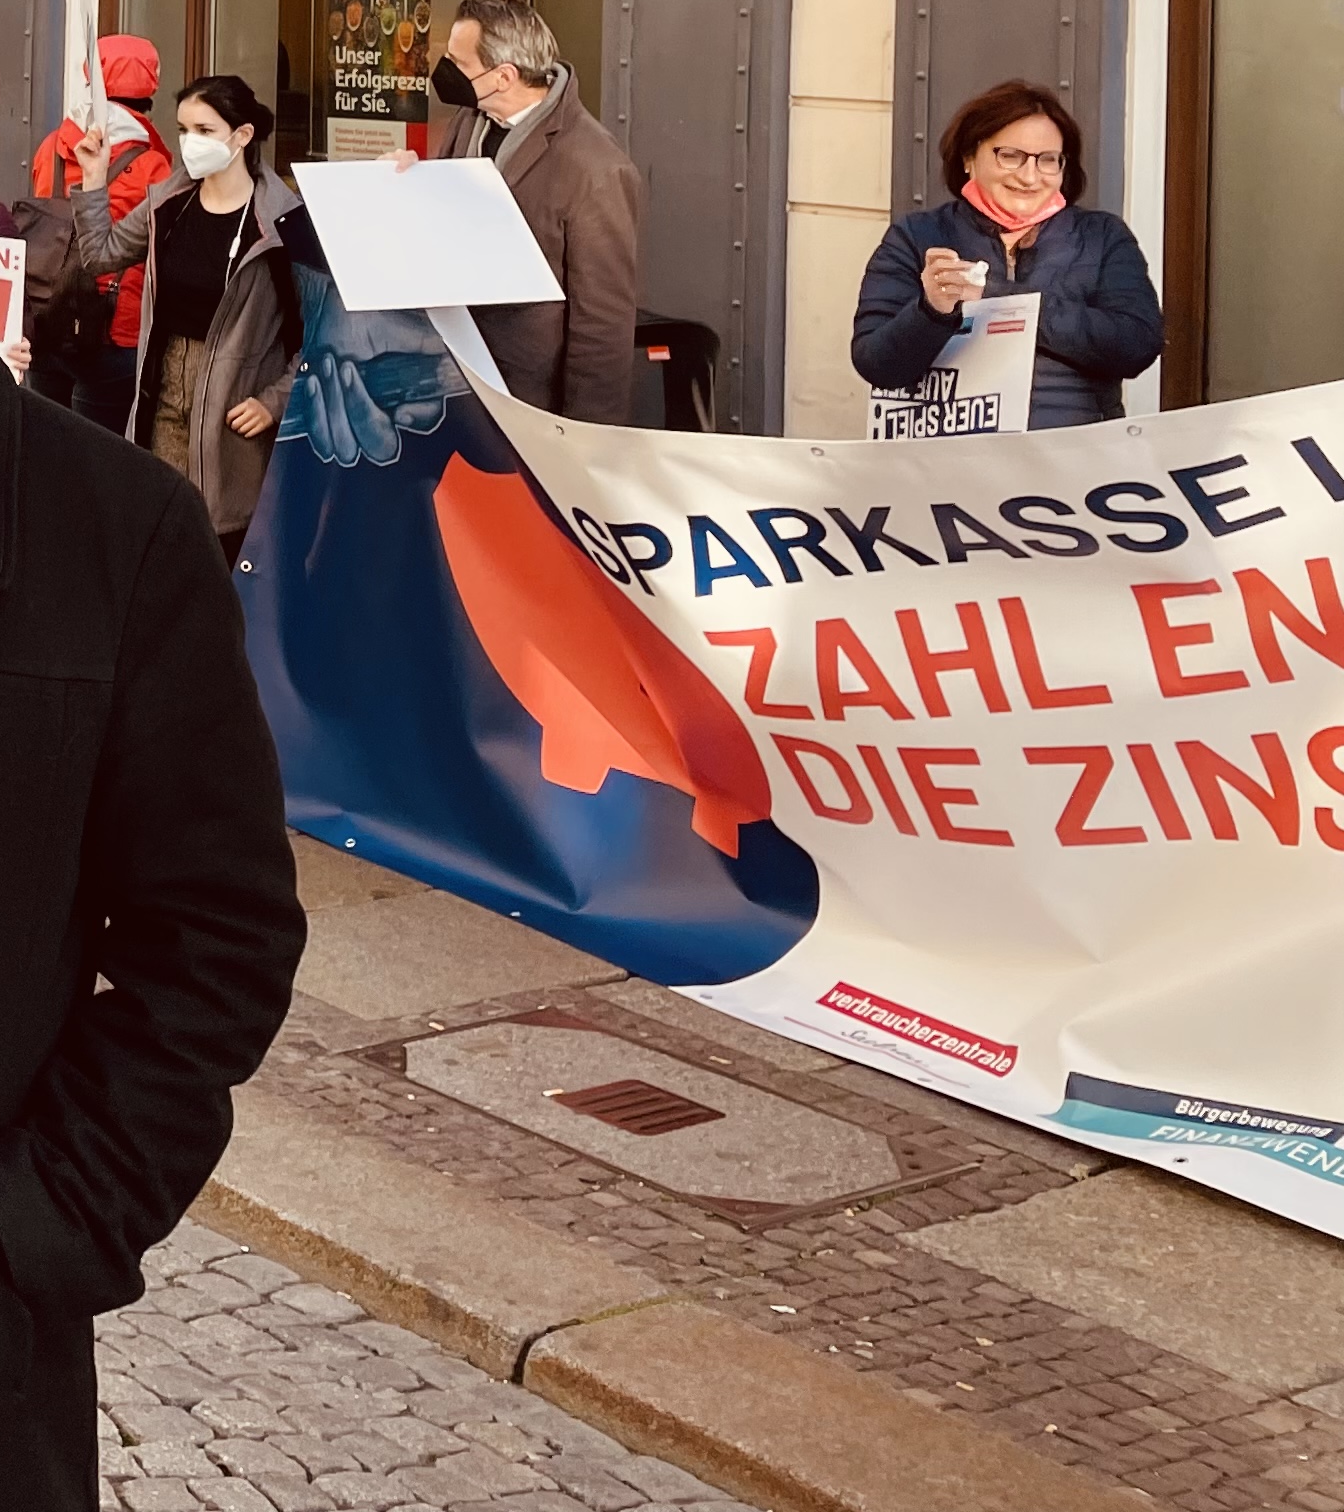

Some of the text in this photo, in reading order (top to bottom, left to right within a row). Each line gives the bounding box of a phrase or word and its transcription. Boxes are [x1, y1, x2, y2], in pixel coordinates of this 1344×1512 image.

[335, 45, 382, 65] Unser
[335, 91, 391, 114] für Sie.
[943, 395, 998, 435] EUER
[572, 454, 1286, 596] SPARKASSE
[704, 596, 1112, 721] ZAHL
[769, 733, 1014, 848] DIE
[827, 989, 1013, 1073] verbraucherzentrale
[1174, 1099, 1335, 1138] Bürgerbewegung
